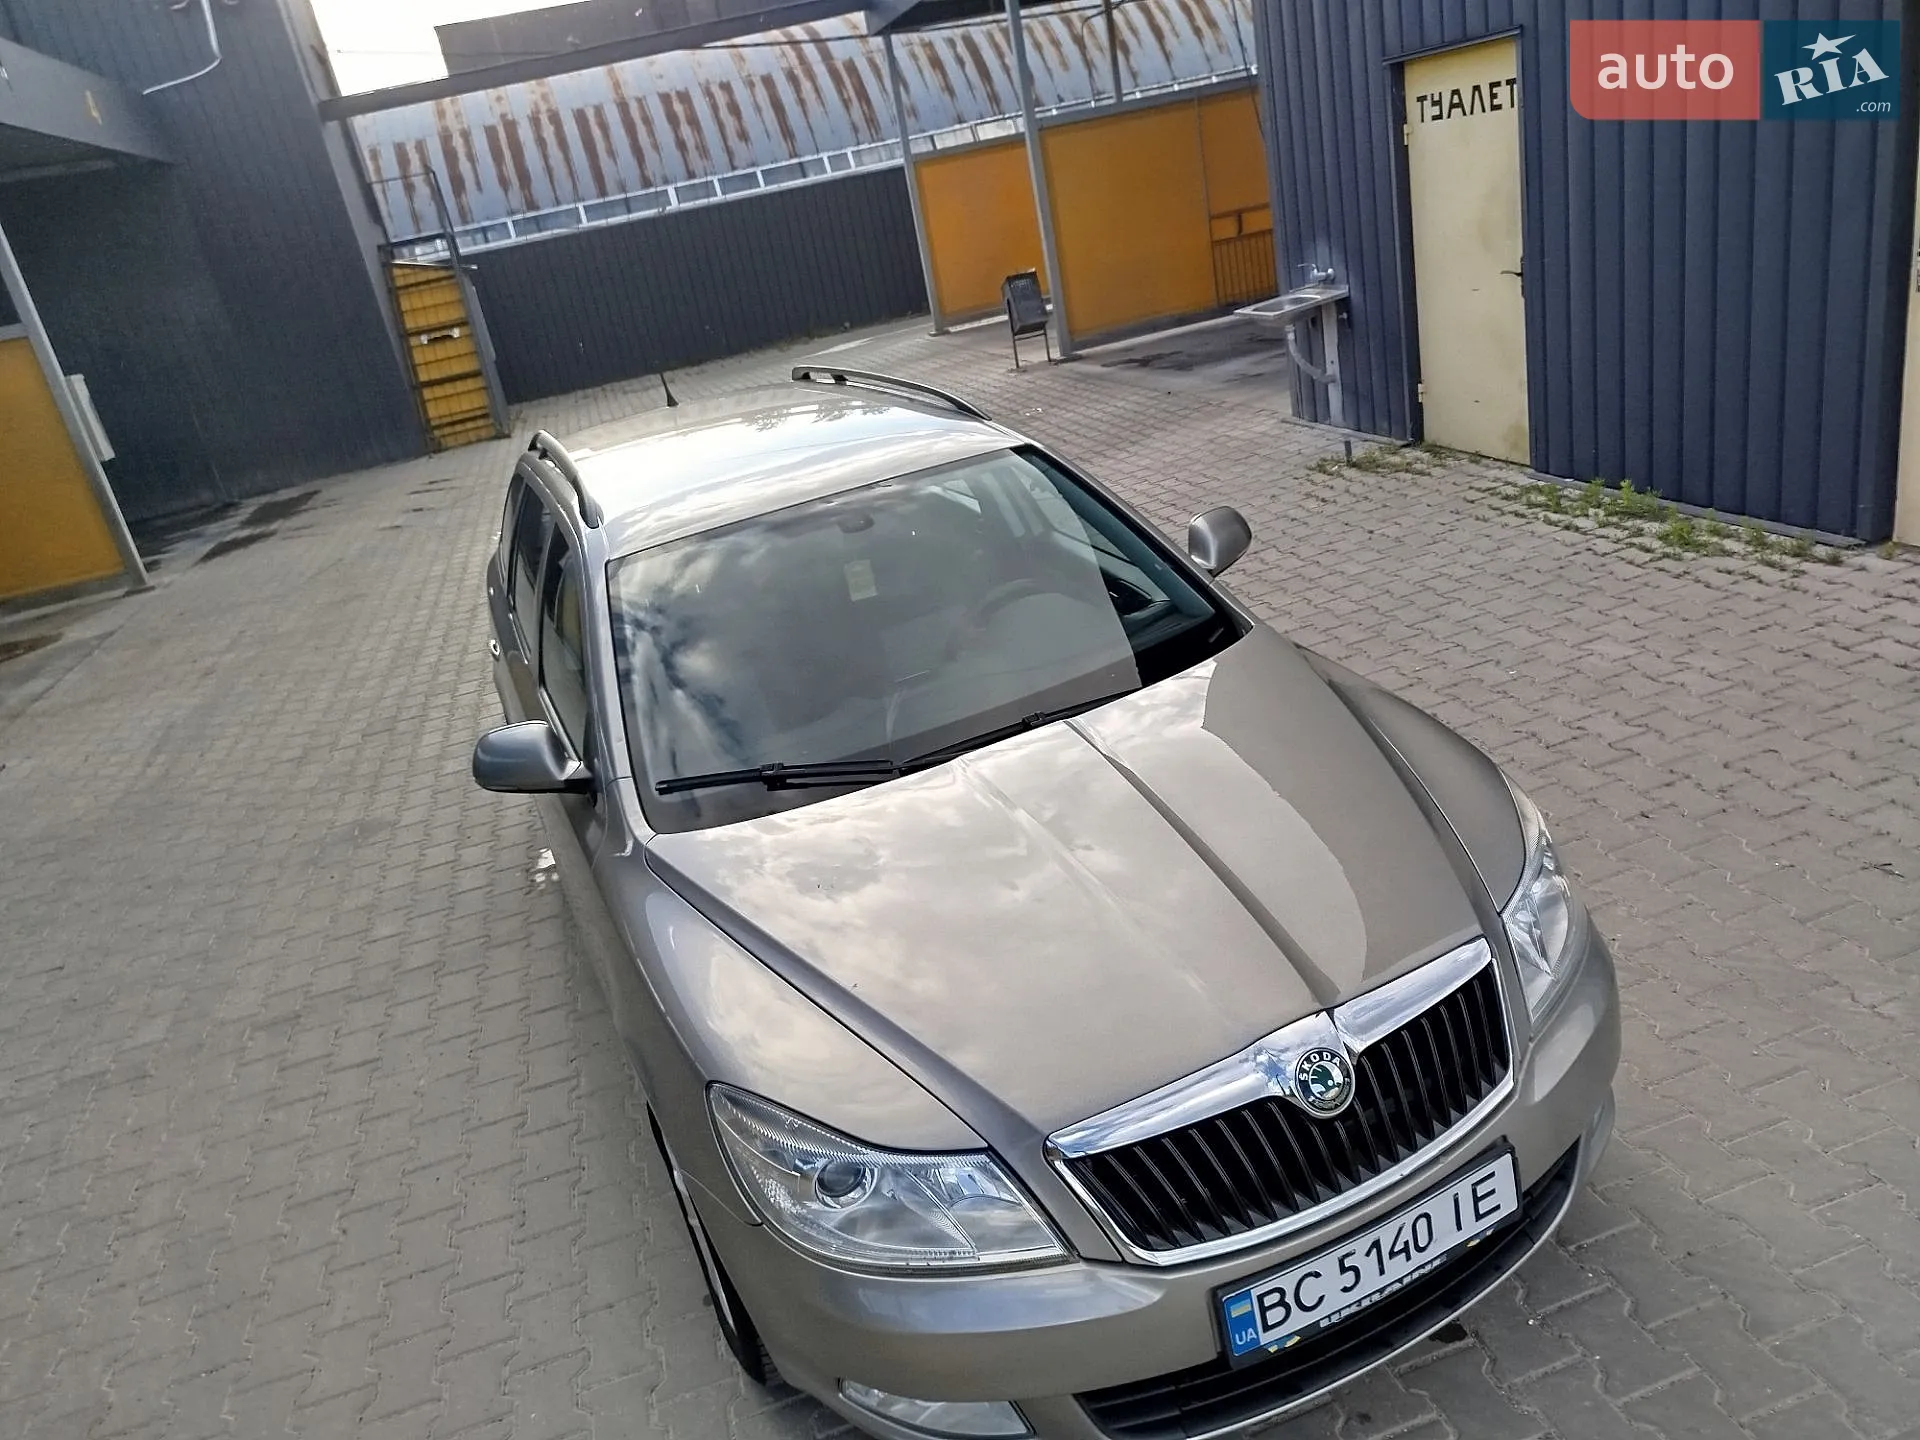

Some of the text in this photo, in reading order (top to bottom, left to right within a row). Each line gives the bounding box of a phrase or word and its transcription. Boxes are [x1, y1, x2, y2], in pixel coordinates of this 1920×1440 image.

[1416, 77, 1517, 123] ТУАЛЕТ
[1256, 1170, 1502, 1334] BC 5140 IE
[1235, 1327, 1258, 1347] UA
